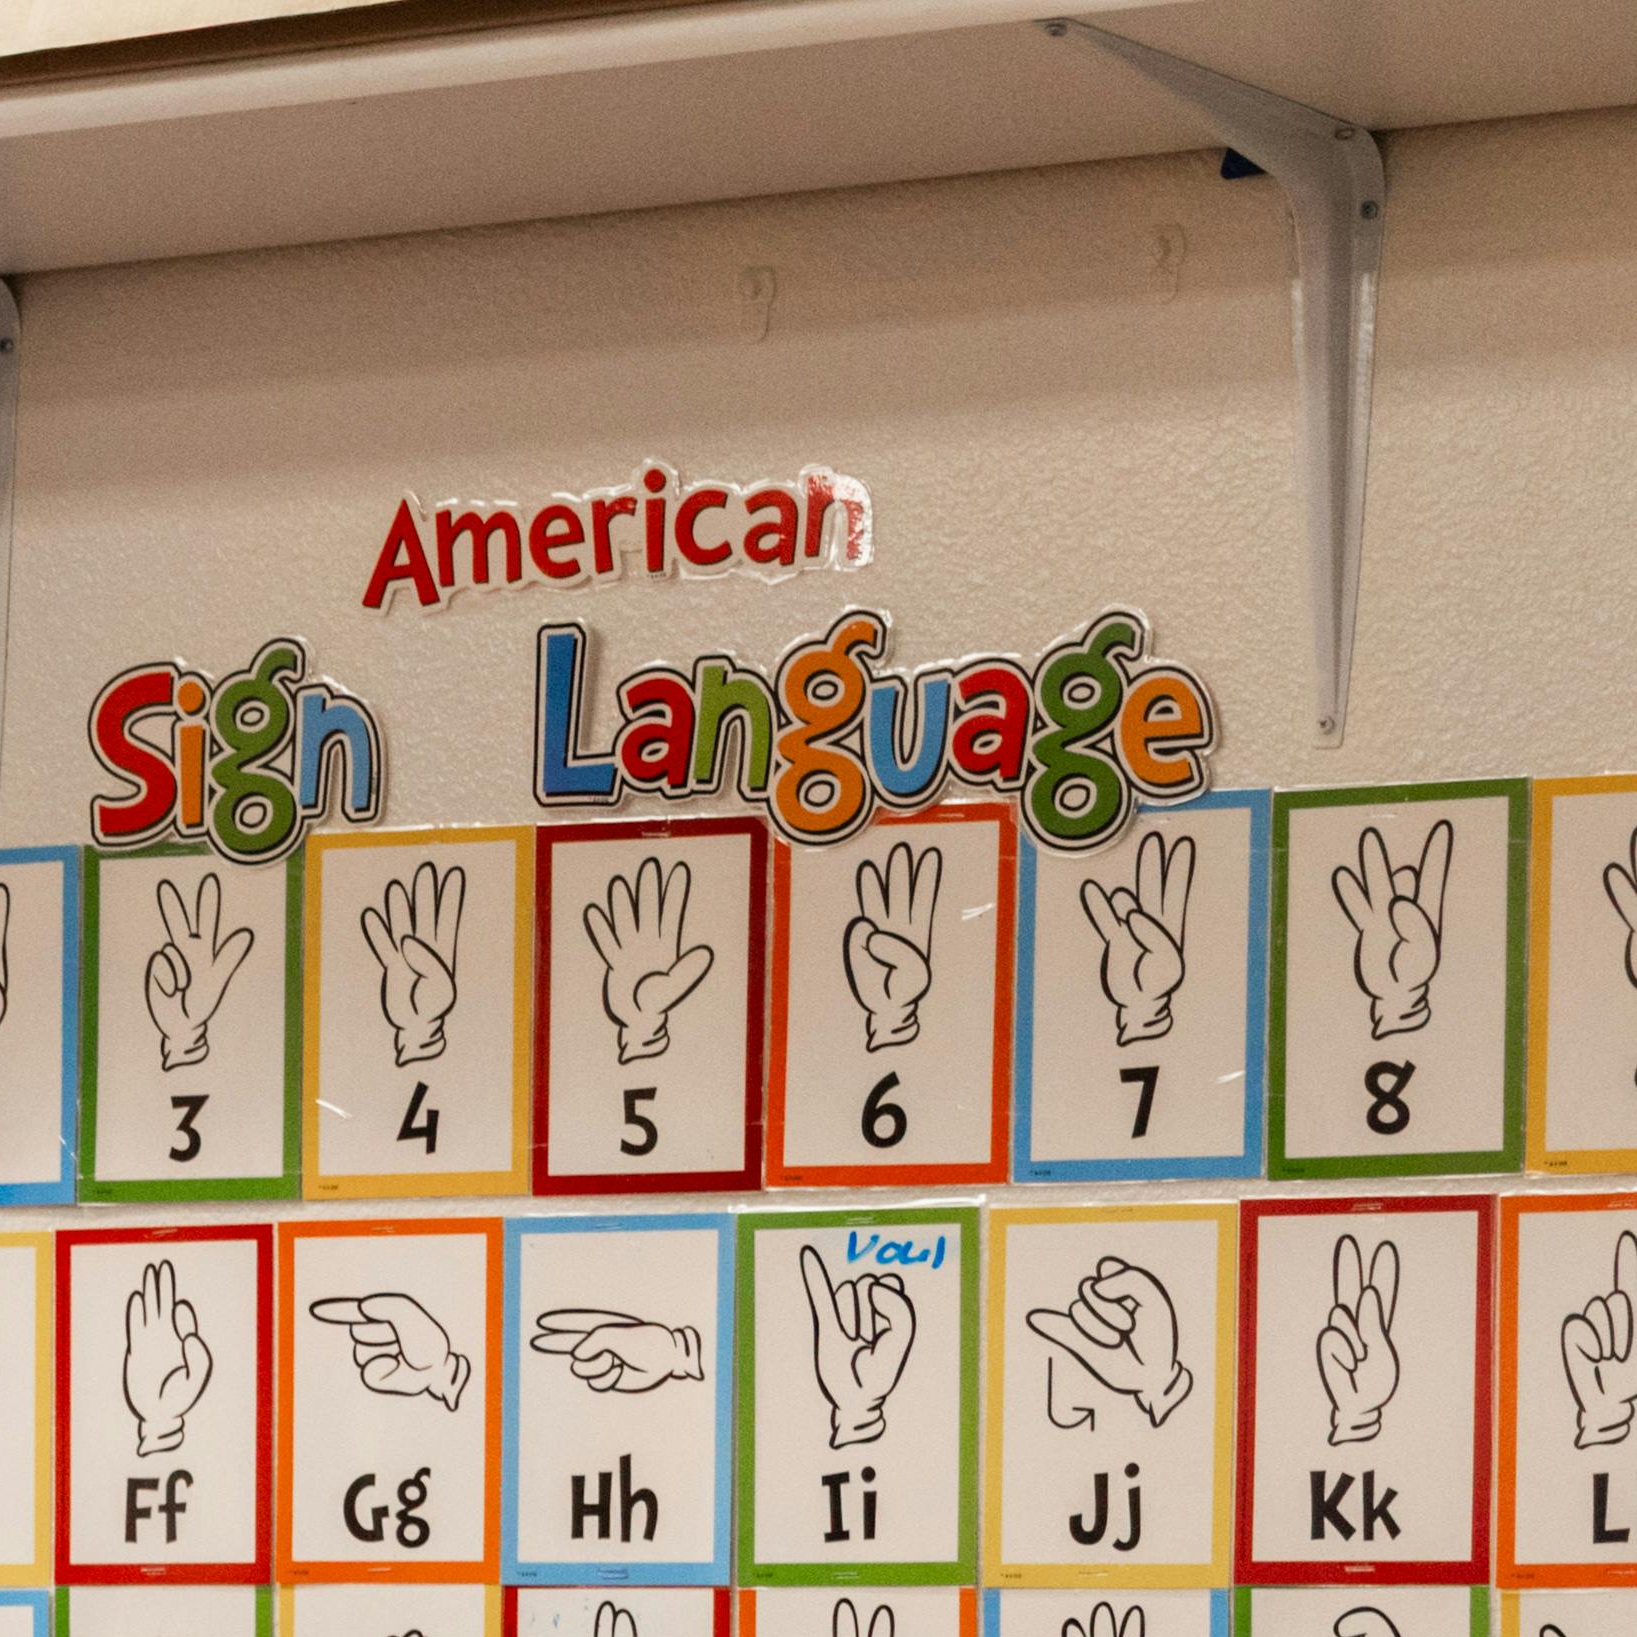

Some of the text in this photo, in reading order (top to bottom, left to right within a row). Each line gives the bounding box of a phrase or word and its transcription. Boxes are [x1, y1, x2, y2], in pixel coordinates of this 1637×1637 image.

[362, 466, 868, 609] American
[91, 614, 1206, 858] Sign Language
[169, 1095, 209, 1162] 3
[397, 1082, 439, 1154] 4
[621, 1087, 658, 1156] 5
[862, 1072, 907, 1148] 6
[1120, 1066, 1159, 1138] 7
[1365, 1061, 1416, 1135] 8
[125, 1470, 193, 1543] Ff
[344, 1467, 431, 1548] Gg
[572, 1454, 658, 1542] Hh
[822, 1467, 876, 1542] Ii
[1070, 1463, 1140, 1551] Jj
[1310, 1470, 1401, 1541] Kk
